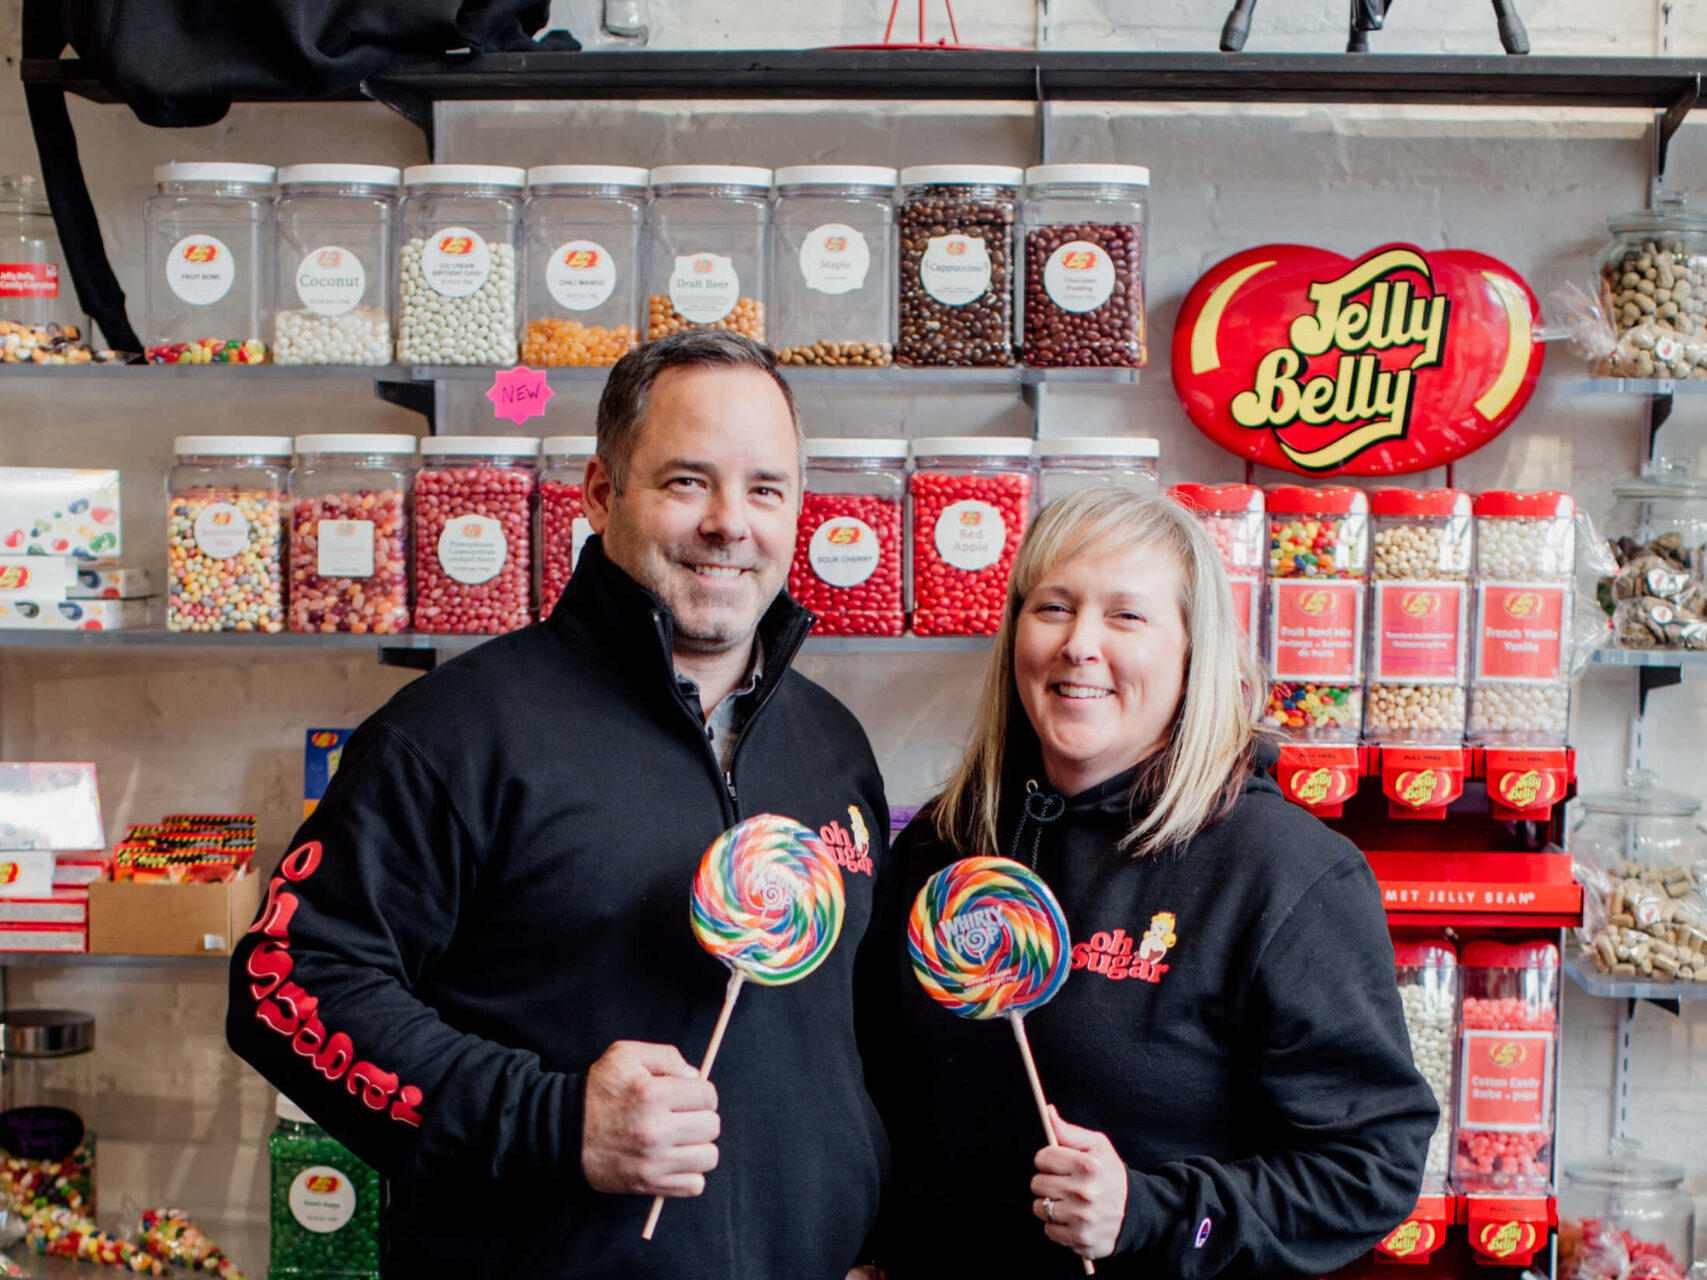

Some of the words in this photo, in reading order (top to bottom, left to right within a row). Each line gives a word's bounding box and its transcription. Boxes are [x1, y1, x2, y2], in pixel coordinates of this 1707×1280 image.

[300, 274, 360, 288] Coconut
[676, 278, 703, 289] Draft
[705, 279, 729, 290] Beer
[1289, 247, 1447, 369] Jelly
[502, 382, 541, 404] NEW
[1231, 346, 1413, 469] Belly
[959, 529, 983, 539] Red
[953, 542, 989, 553] Apple
[1281, 626, 1305, 637] Fruit
[1306, 626, 1332, 638] Bowl
[1485, 627, 1522, 638] French
[1523, 628, 1558, 640] Vanilla
[1310, 768, 1333, 788] Jelly
[1411, 769, 1438, 789] Jelly
[1516, 770, 1542, 790] Jelly
[1297, 783, 1328, 804] Belly
[1402, 784, 1432, 806] Belly
[1506, 785, 1537, 807] Belly
[827, 845, 873, 877] ugar
[1428, 890, 1475, 903] JELLY
[938, 903, 1004, 942] WHIRLY
[1090, 928, 1134, 956] oh
[1071, 942, 1170, 984] Sugar
[1471, 1075, 1508, 1088] Cotton
[1509, 1076, 1540, 1090] Candy
[1498, 1220, 1523, 1240] Jelly
[1387, 1234, 1417, 1257] Belly
[1488, 1235, 1518, 1258] Belly
